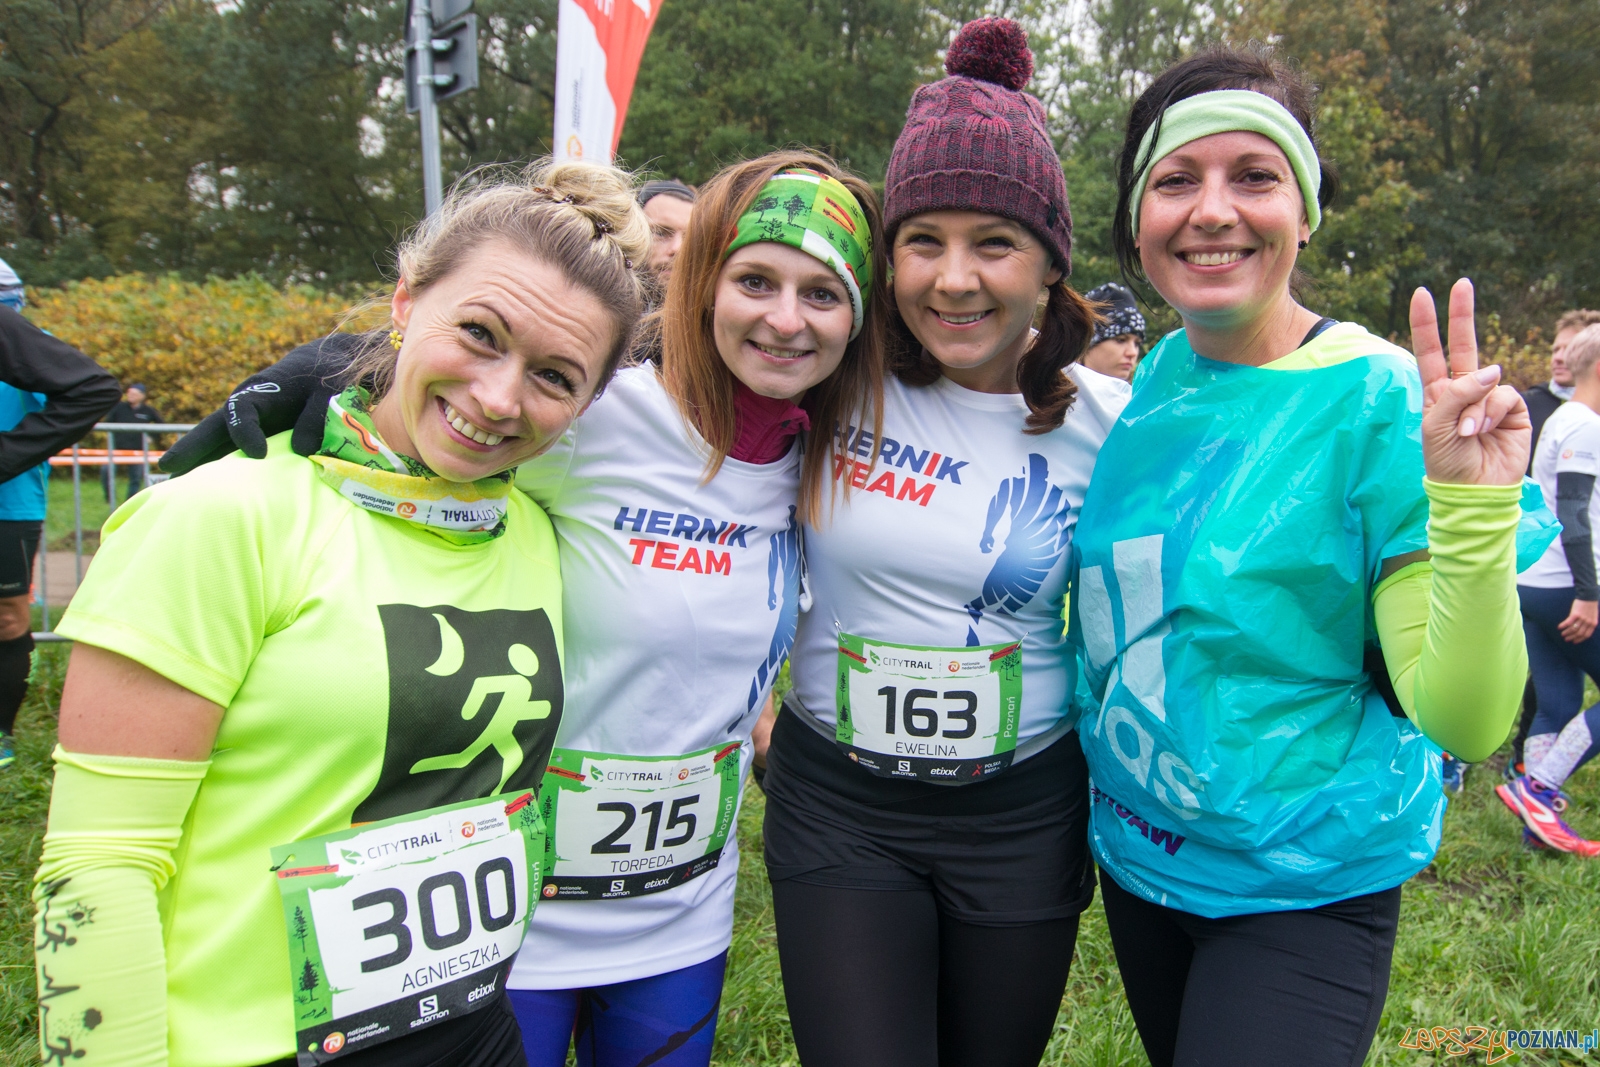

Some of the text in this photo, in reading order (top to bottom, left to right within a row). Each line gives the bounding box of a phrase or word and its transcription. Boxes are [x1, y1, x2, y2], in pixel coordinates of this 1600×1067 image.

[834, 454, 937, 508] TEAM
[352, 491, 395, 507] nederlanden
[361, 501, 394, 513] nationale
[613, 506, 758, 549] HERNIK
[628, 538, 732, 576] TEAM
[877, 685, 978, 740] 163
[1003, 696, 1016, 739] Poznań
[895, 741, 958, 757] EWELINA
[476, 817, 498, 827] nationale
[477, 821, 504, 832] nederlanden
[590, 793, 701, 855] 215
[716, 796, 734, 838] Poznań
[610, 853, 674, 873] TORPEDA
[1126, 870, 1156, 900] MARATON
[352, 856, 516, 974] 300
[401, 943, 501, 993] AGNIESZKA
[347, 1022, 379, 1038] nationale
[410, 1009, 450, 1028] salomon
[347, 1025, 390, 1044] nederlanden
